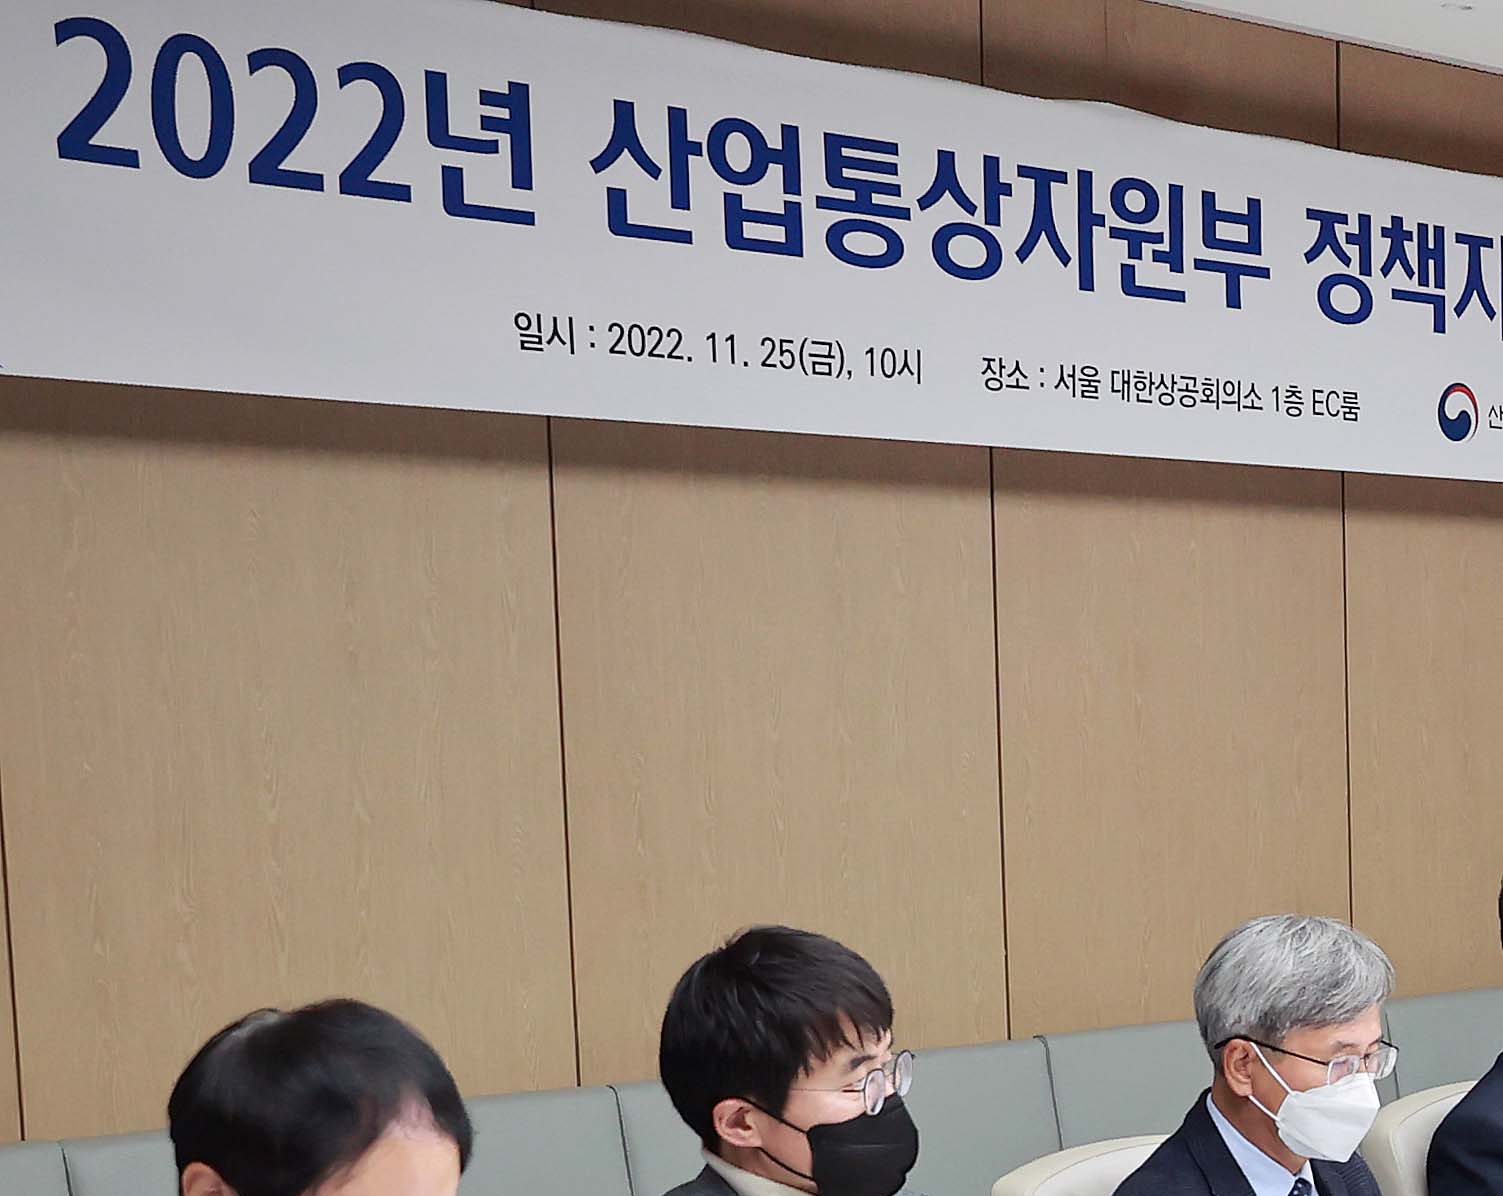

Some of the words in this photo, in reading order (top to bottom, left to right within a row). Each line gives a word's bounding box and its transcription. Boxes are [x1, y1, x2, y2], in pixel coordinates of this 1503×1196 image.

[53, 17, 538, 228] 2022년
[590, 99, 1272, 310] 산업통상자원부
[513, 311, 576, 355] 일시
[607, 322, 694, 363] 2022.
[705, 332, 750, 368] 11.
[759, 337, 854, 380] 25(금),
[864, 347, 923, 385] 10시
[980, 356, 1031, 391] 장소
[1054, 363, 1102, 400] 서울
[1110, 368, 1264, 413] 대한상공회의소
[1271, 384, 1305, 418] 1층
[1312, 389, 1361, 422] EC룸
